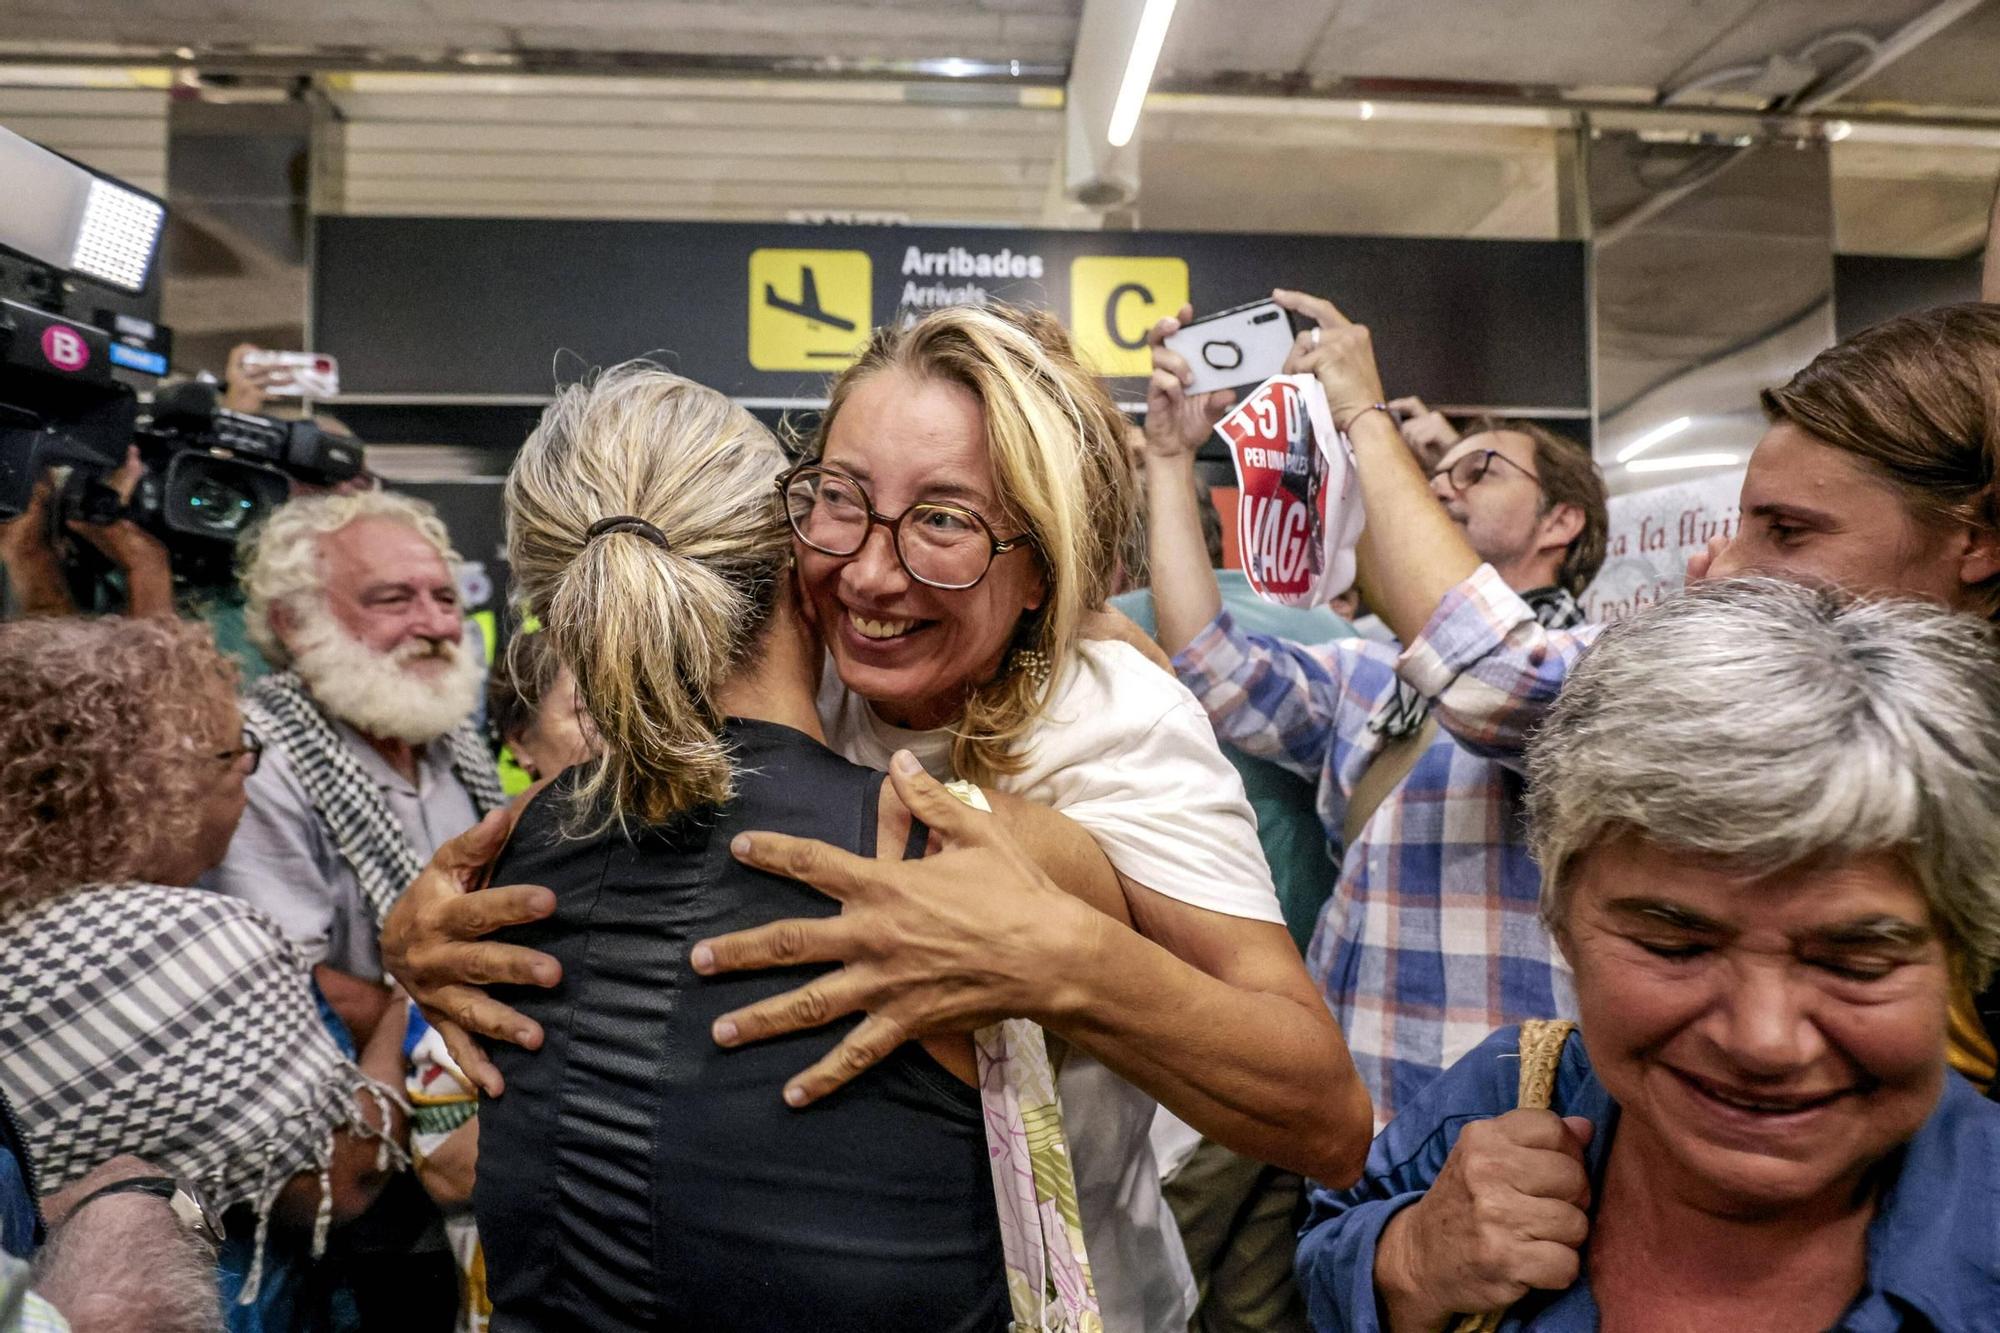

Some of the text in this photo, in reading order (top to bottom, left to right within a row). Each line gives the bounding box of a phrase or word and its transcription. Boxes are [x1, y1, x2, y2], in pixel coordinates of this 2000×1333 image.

[902, 246, 1043, 278] Arribades
[901, 281, 987, 308] Arrivals
[1105, 283, 1154, 350] C
[52, 331, 81, 365] B
[1243, 447, 1267, 469] PER
[1640, 515, 1665, 552] la
